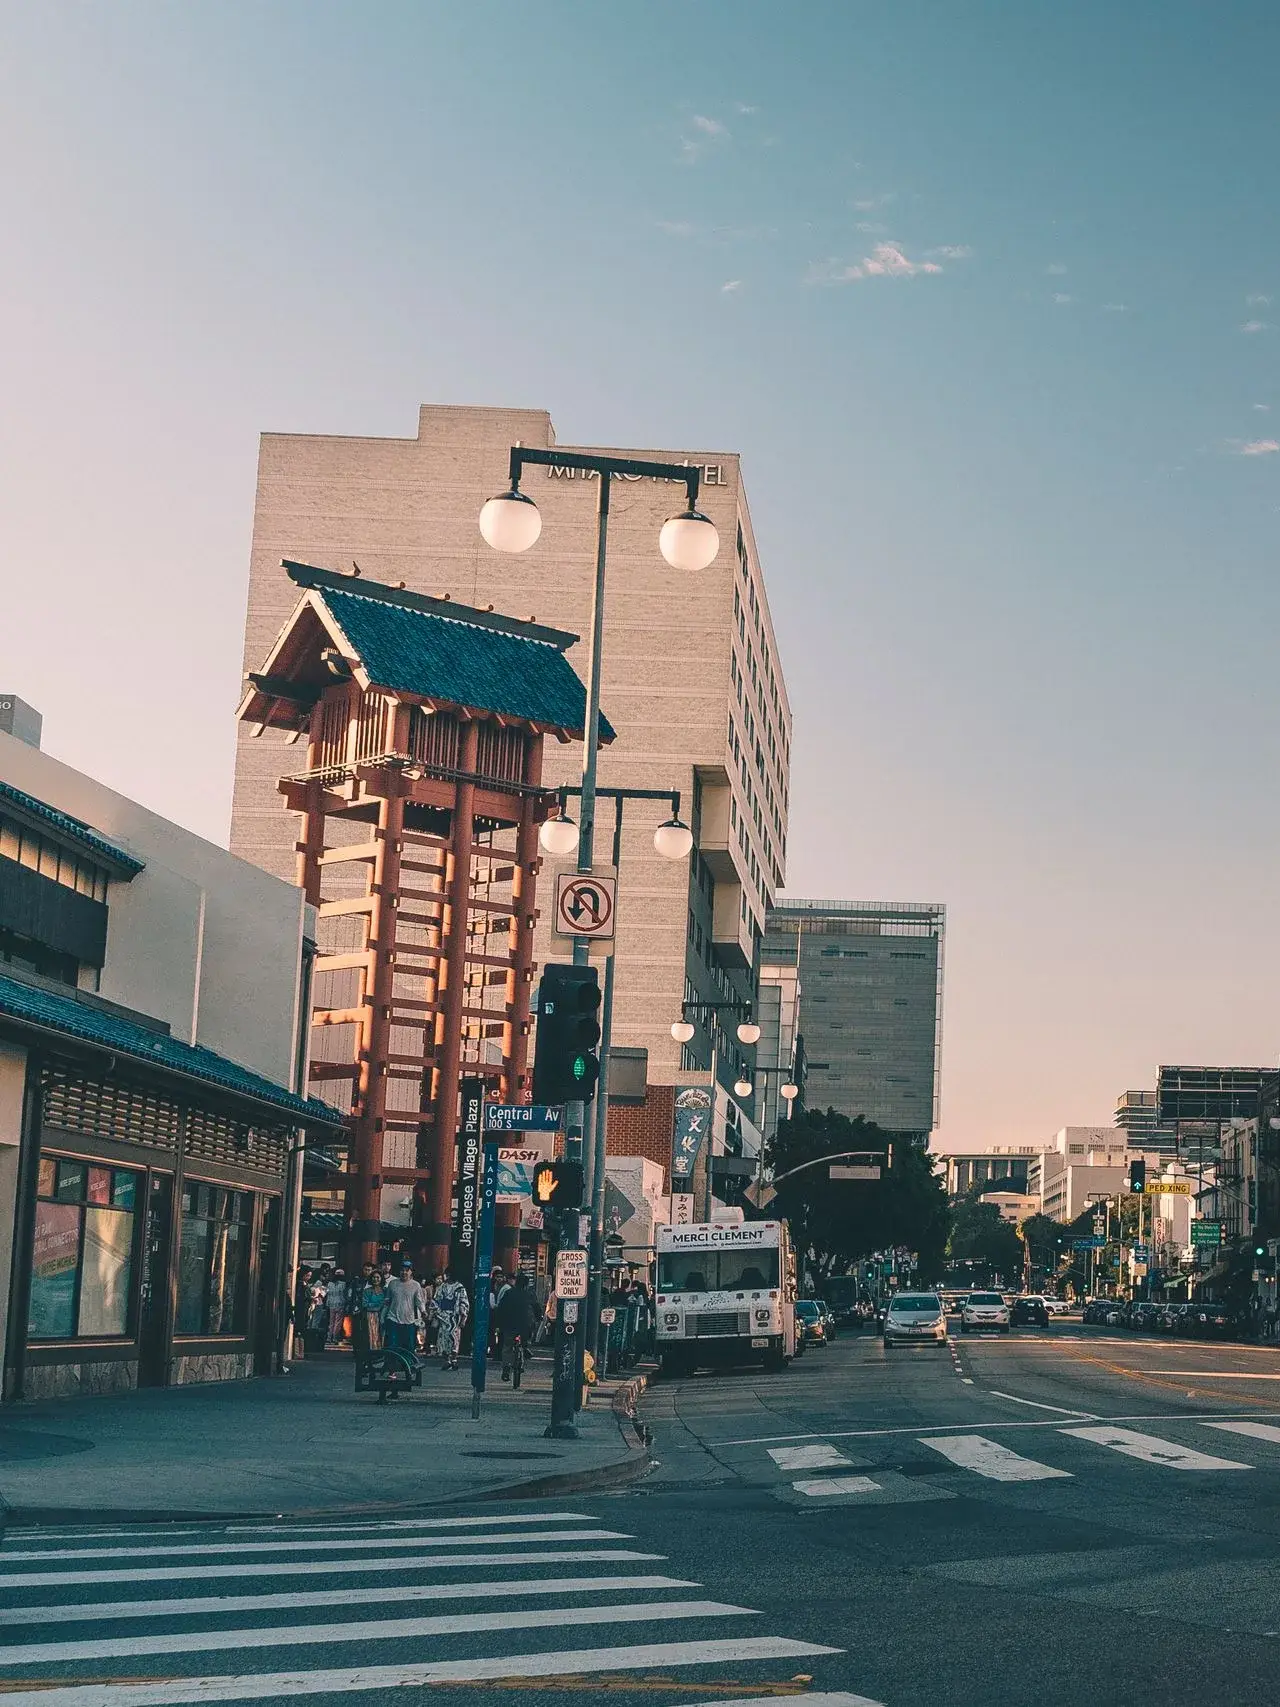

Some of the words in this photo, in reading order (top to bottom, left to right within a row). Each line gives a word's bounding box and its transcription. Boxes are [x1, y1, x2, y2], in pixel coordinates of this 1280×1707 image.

[466, 1099, 478, 1132] Plaza
[489, 1106, 532, 1121] Central
[545, 1109, 559, 1122] Av
[488, 1120, 502, 1129] 100
[506, 1120, 512, 1129] S
[674, 1114, 704, 1174] 文化堂
[463, 1138, 478, 1181] Village
[500, 1150, 540, 1160] DASH
[486, 1154, 495, 1208] LADOT
[1149, 1184, 1165, 1192] PED
[459, 1185, 474, 1247] Japanese
[673, 1233, 708, 1243] MERCI
[711, 1230, 764, 1241] CLEMENT
[561, 1253, 583, 1261] CROSS
[563, 1269, 580, 1277] WALK
[560, 1278, 583, 1286] SIGNAL
[562, 1287, 579, 1295] ONLY
